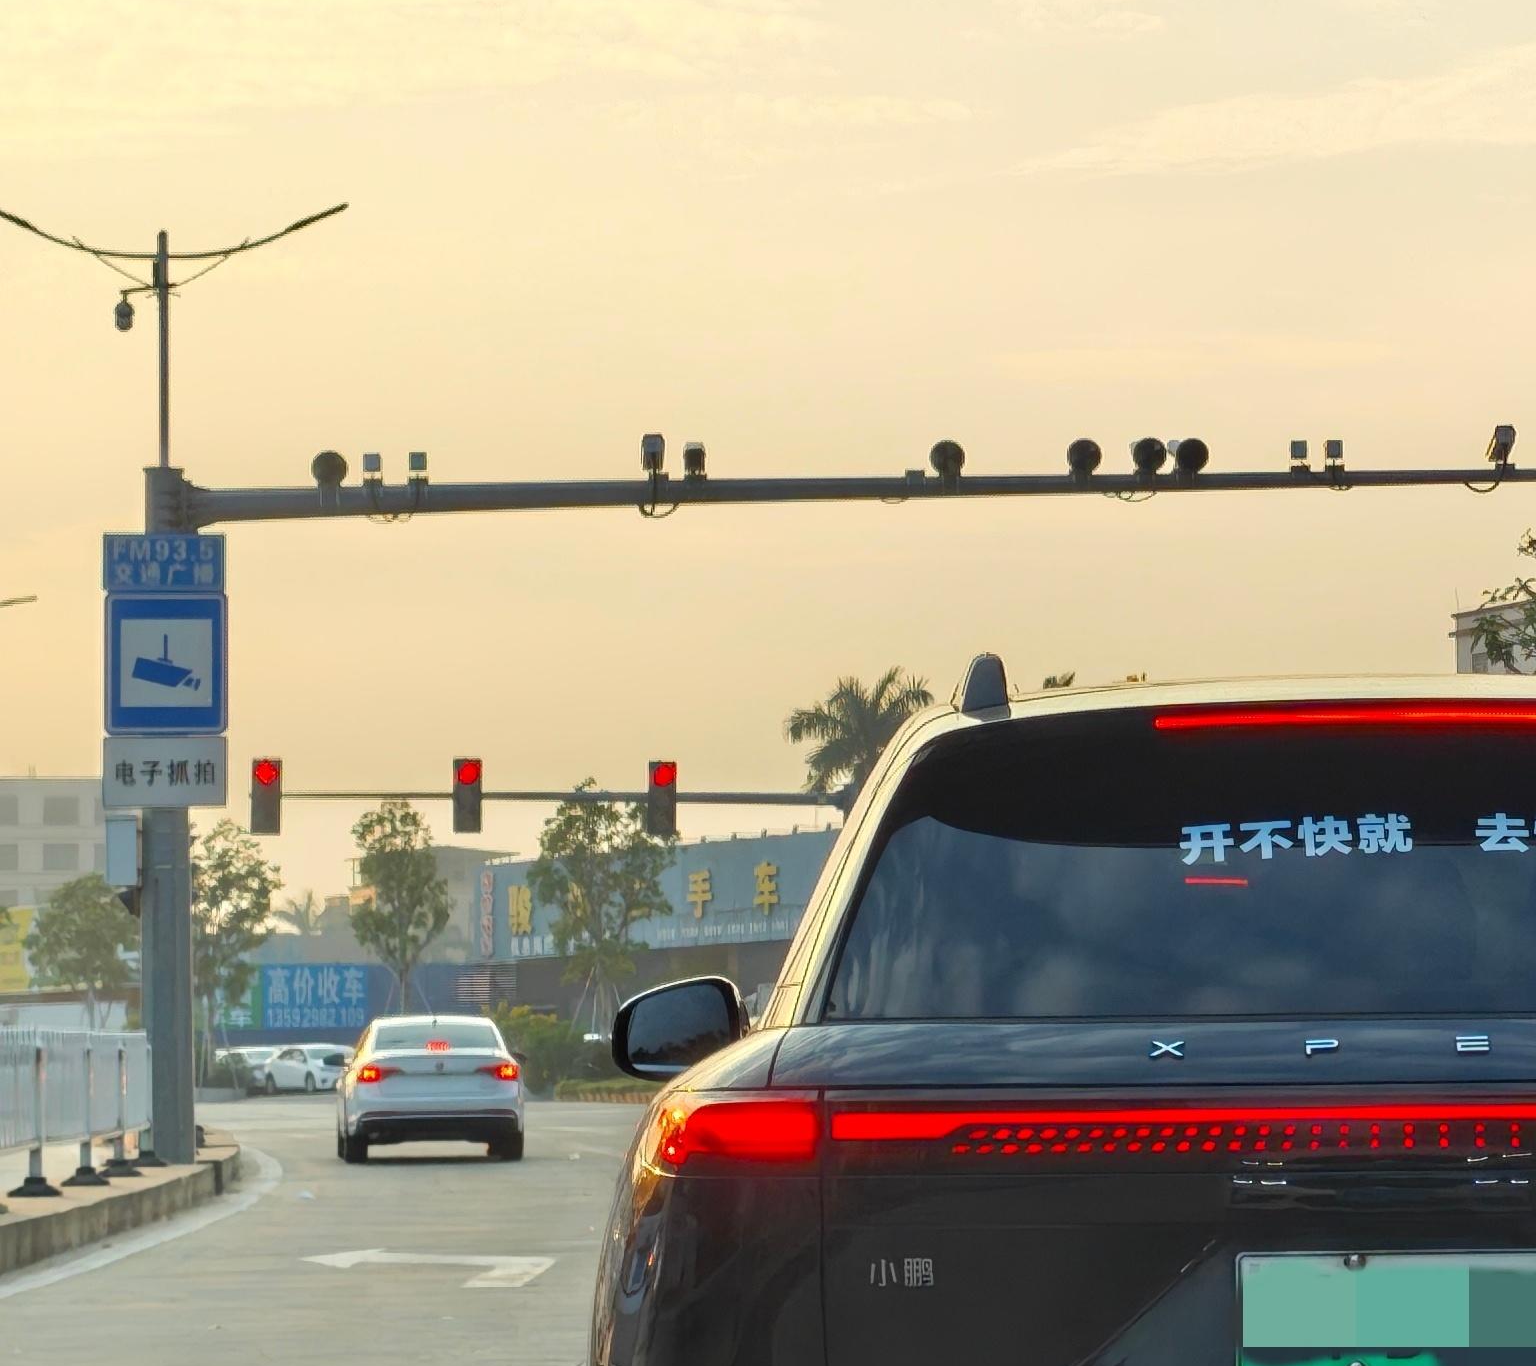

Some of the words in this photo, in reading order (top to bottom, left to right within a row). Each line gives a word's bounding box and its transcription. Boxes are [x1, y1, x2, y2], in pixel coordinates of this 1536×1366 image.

[112, 538, 214, 563] FM93.5
[115, 759, 217, 787] 电子抓拍
[1180, 813, 1413, 865] 开不快就
[266, 967, 366, 1005] 高价收车
[869, 1257, 934, 1288] 小鹏
